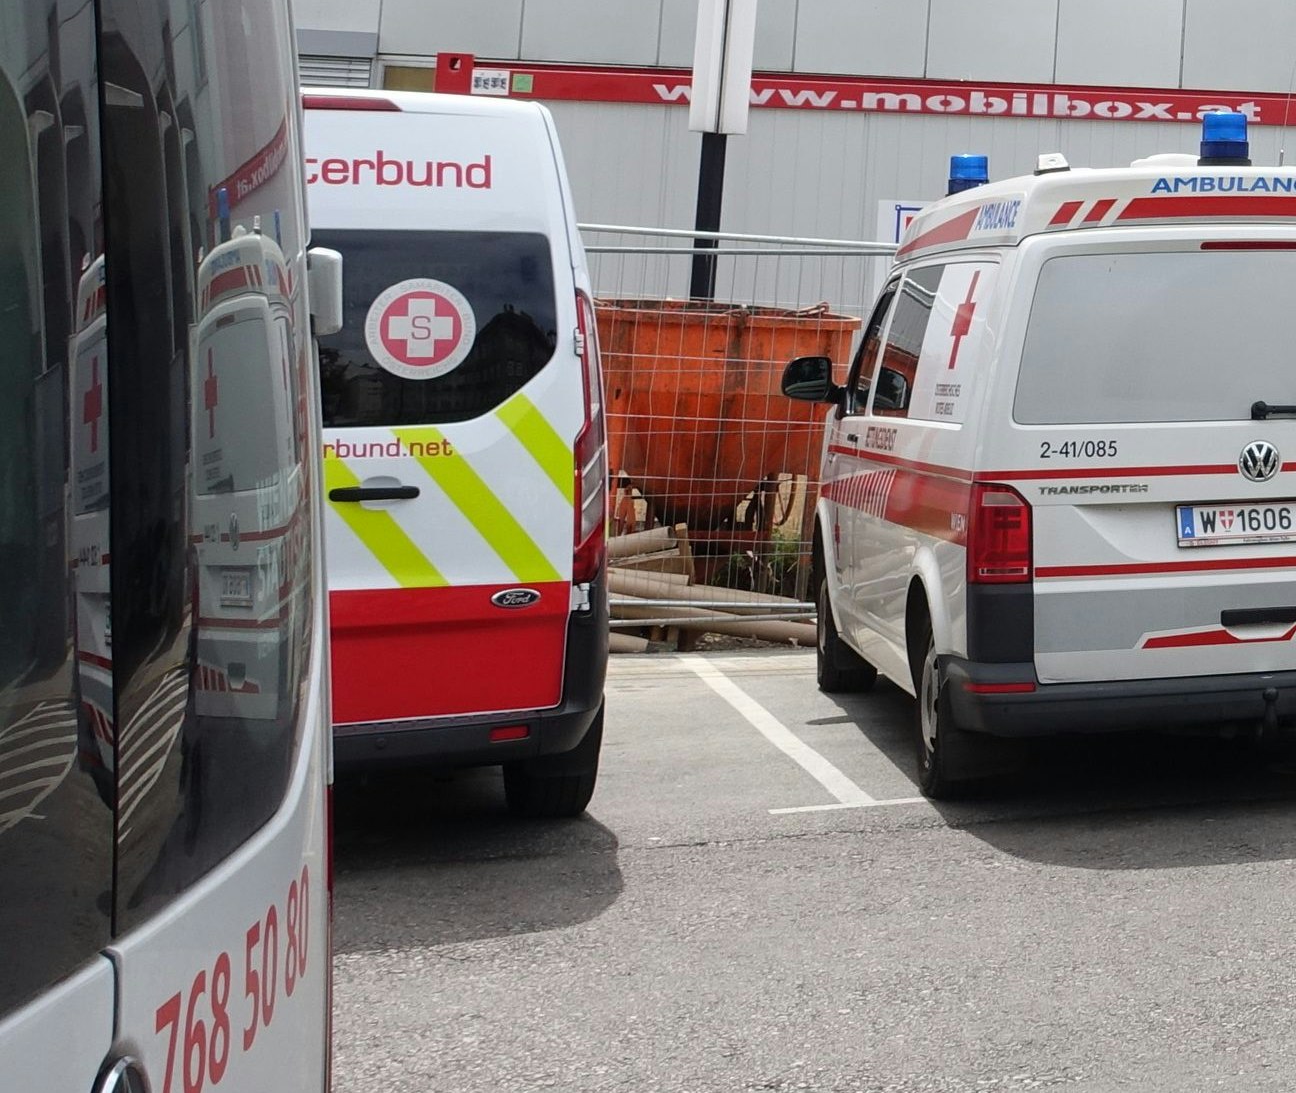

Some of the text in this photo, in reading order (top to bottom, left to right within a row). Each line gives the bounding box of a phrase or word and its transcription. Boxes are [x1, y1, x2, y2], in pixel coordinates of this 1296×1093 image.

[975, 200, 1021, 231] AMBULANCE
[411, 315, 431, 340] S
[1039, 439, 1118, 459] 2-41/085
[1038, 484, 1149, 495] TRANSPORTER
[1200, 511, 1216, 534] W
[503, 592, 531, 605] Ford
[243, 904, 278, 1051] 50
[285, 864, 309, 997] 80
